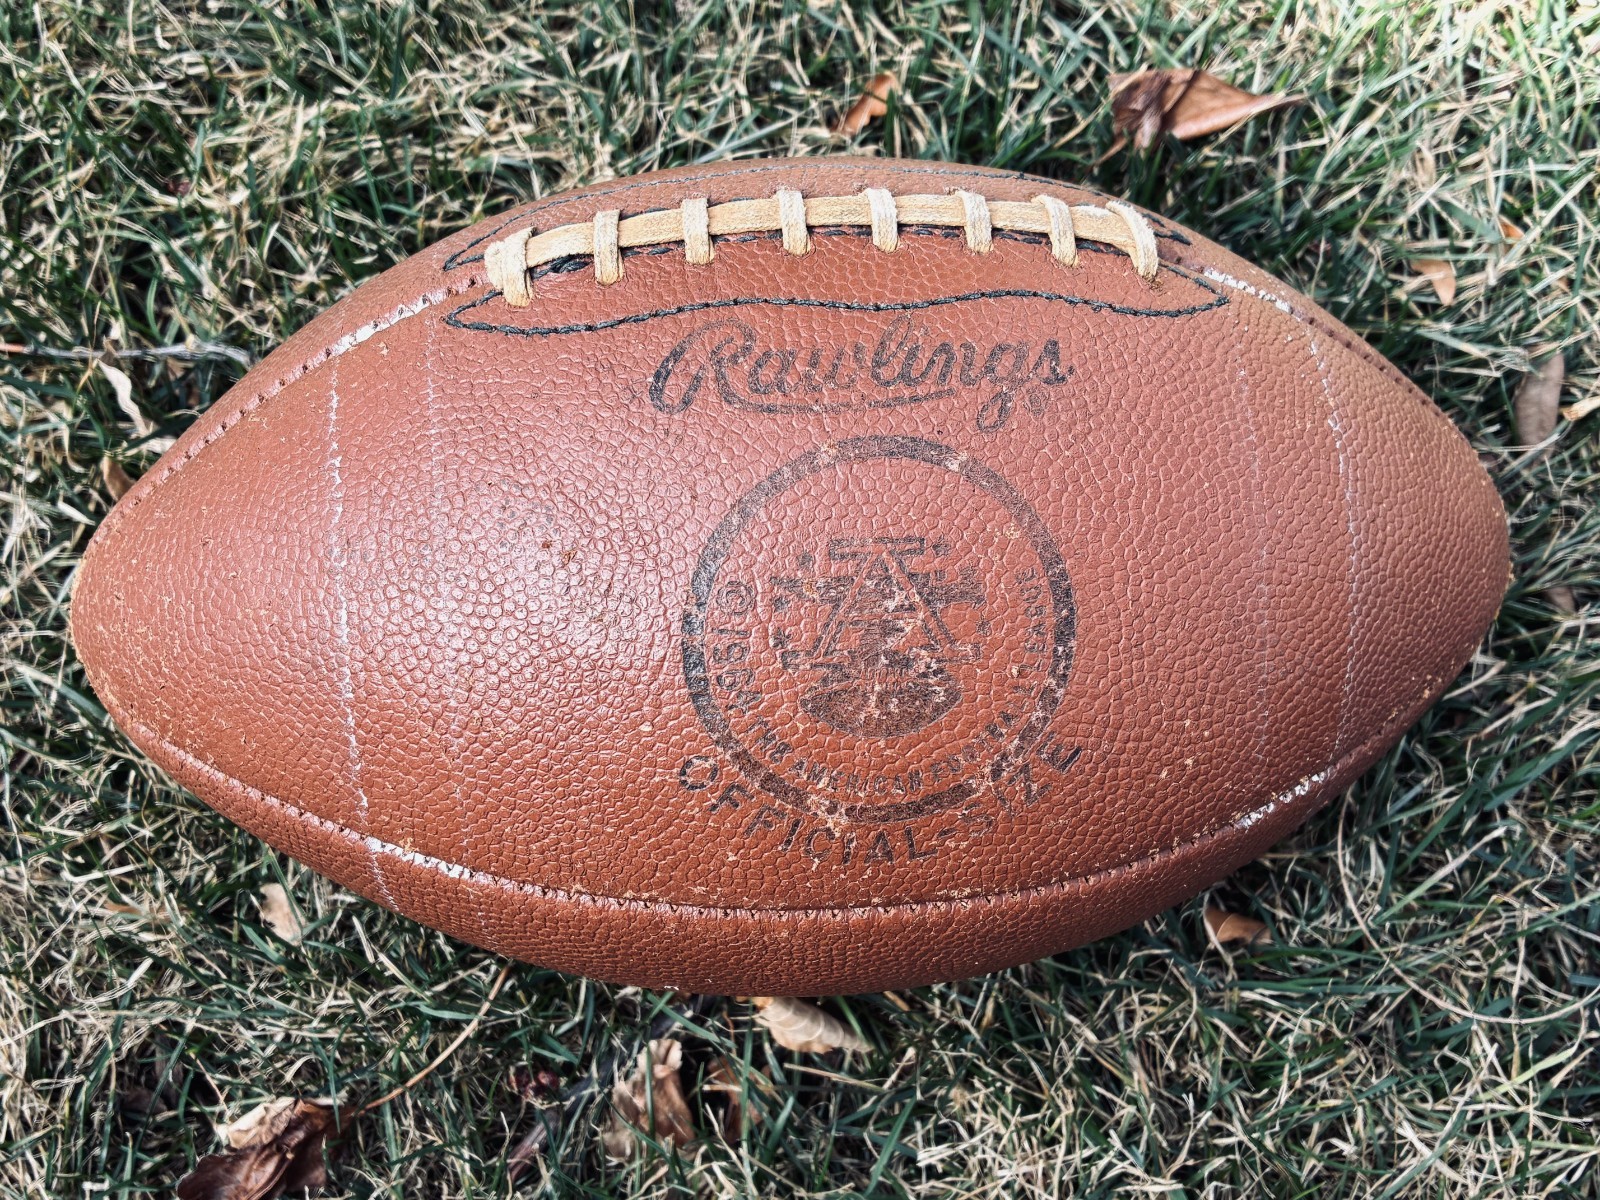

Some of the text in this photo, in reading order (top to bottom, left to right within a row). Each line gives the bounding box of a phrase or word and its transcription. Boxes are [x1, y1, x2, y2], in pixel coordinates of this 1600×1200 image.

[649, 314, 1076, 433] Rawlings
[748, 714, 794, 764] THE
[789, 760, 924, 797] AMERICAN
